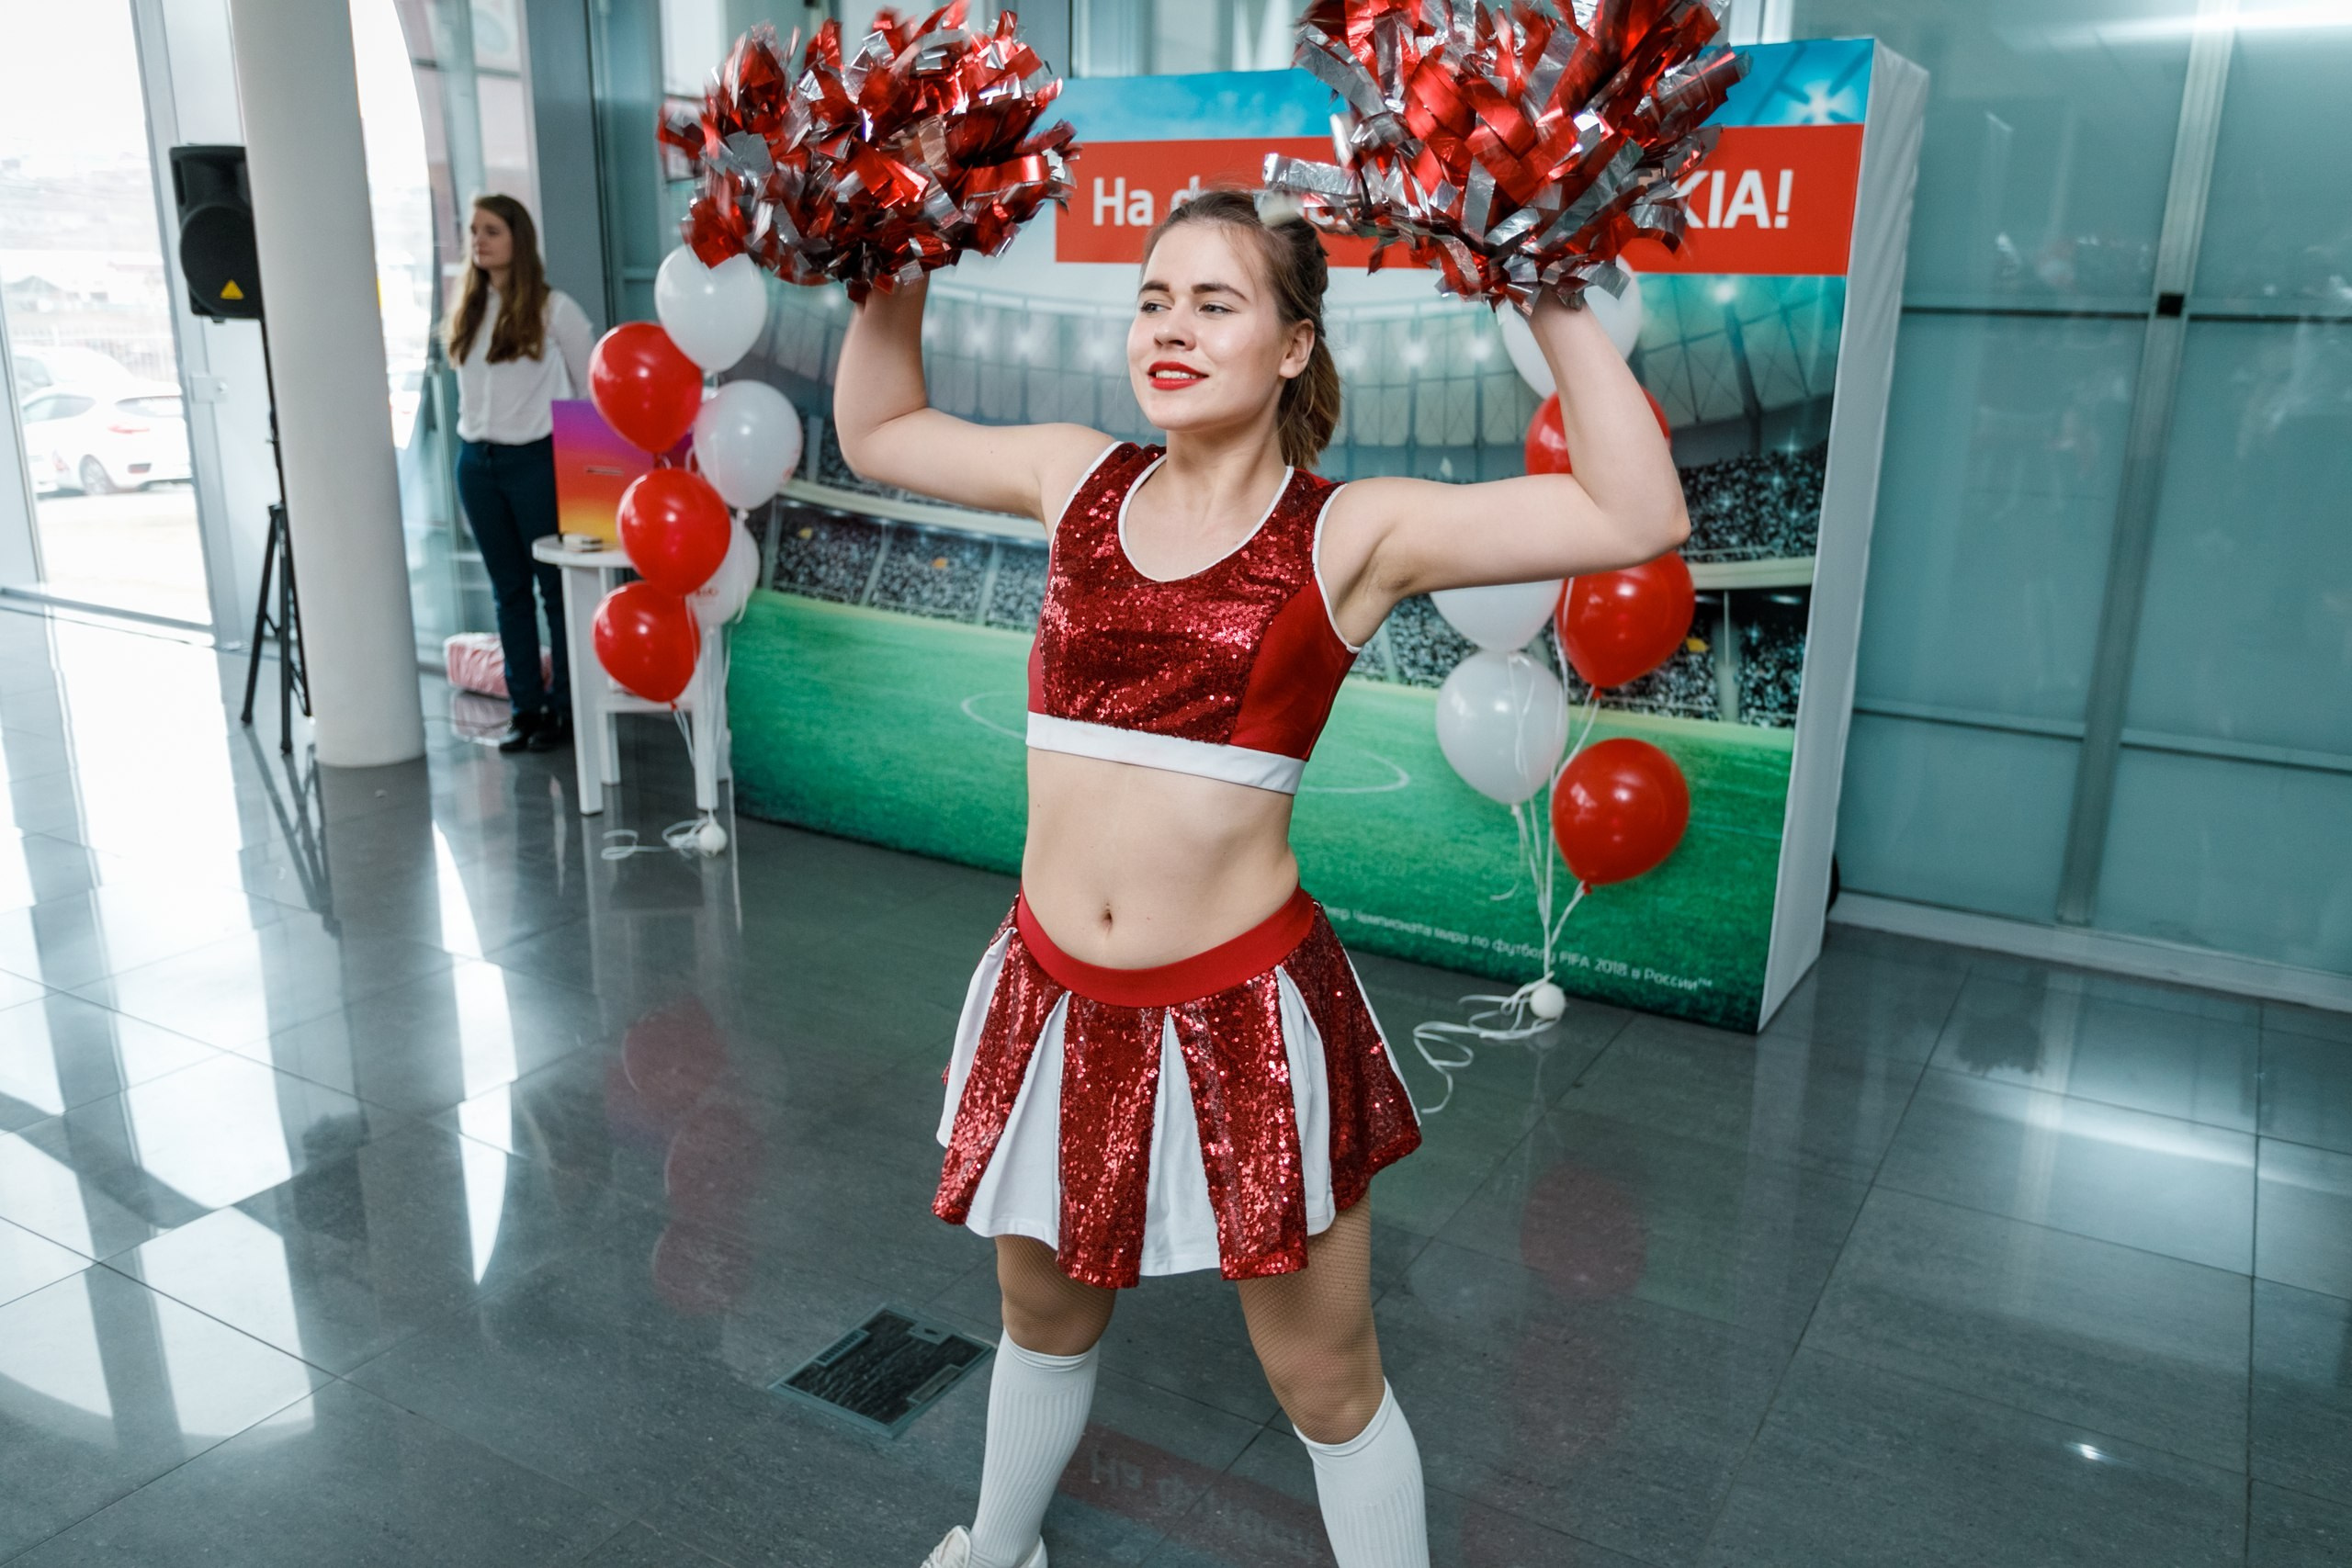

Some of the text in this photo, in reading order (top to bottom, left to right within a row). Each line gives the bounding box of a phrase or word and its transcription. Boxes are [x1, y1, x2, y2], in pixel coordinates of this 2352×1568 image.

[1093, 176, 1154, 226] На
[1668, 169, 1794, 229] KIA!
[1472, 935, 1490, 949] по
[1559, 949, 1590, 968] FIFA
[1595, 957, 1628, 976] 2018
[1631, 968, 1640, 980] в
